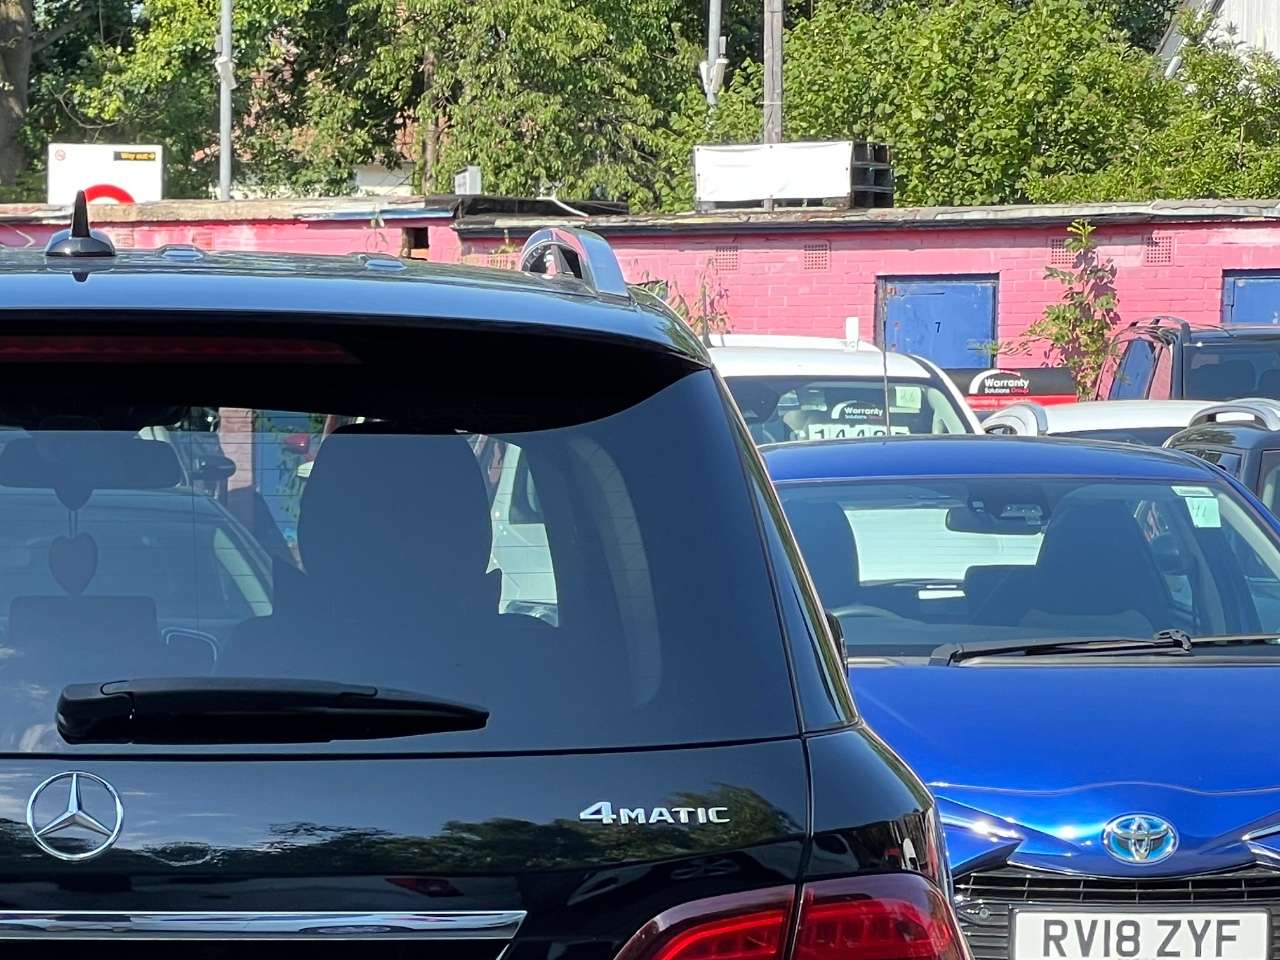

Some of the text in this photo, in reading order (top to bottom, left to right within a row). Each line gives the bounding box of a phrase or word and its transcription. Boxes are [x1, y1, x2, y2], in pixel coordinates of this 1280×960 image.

[935, 322, 941, 333] 7
[985, 378, 1029, 388] Warranty
[844, 407, 883, 416] Warranty
[579, 801, 731, 825] 4MATIC
[1043, 919, 1241, 958] RV18 ZYF
